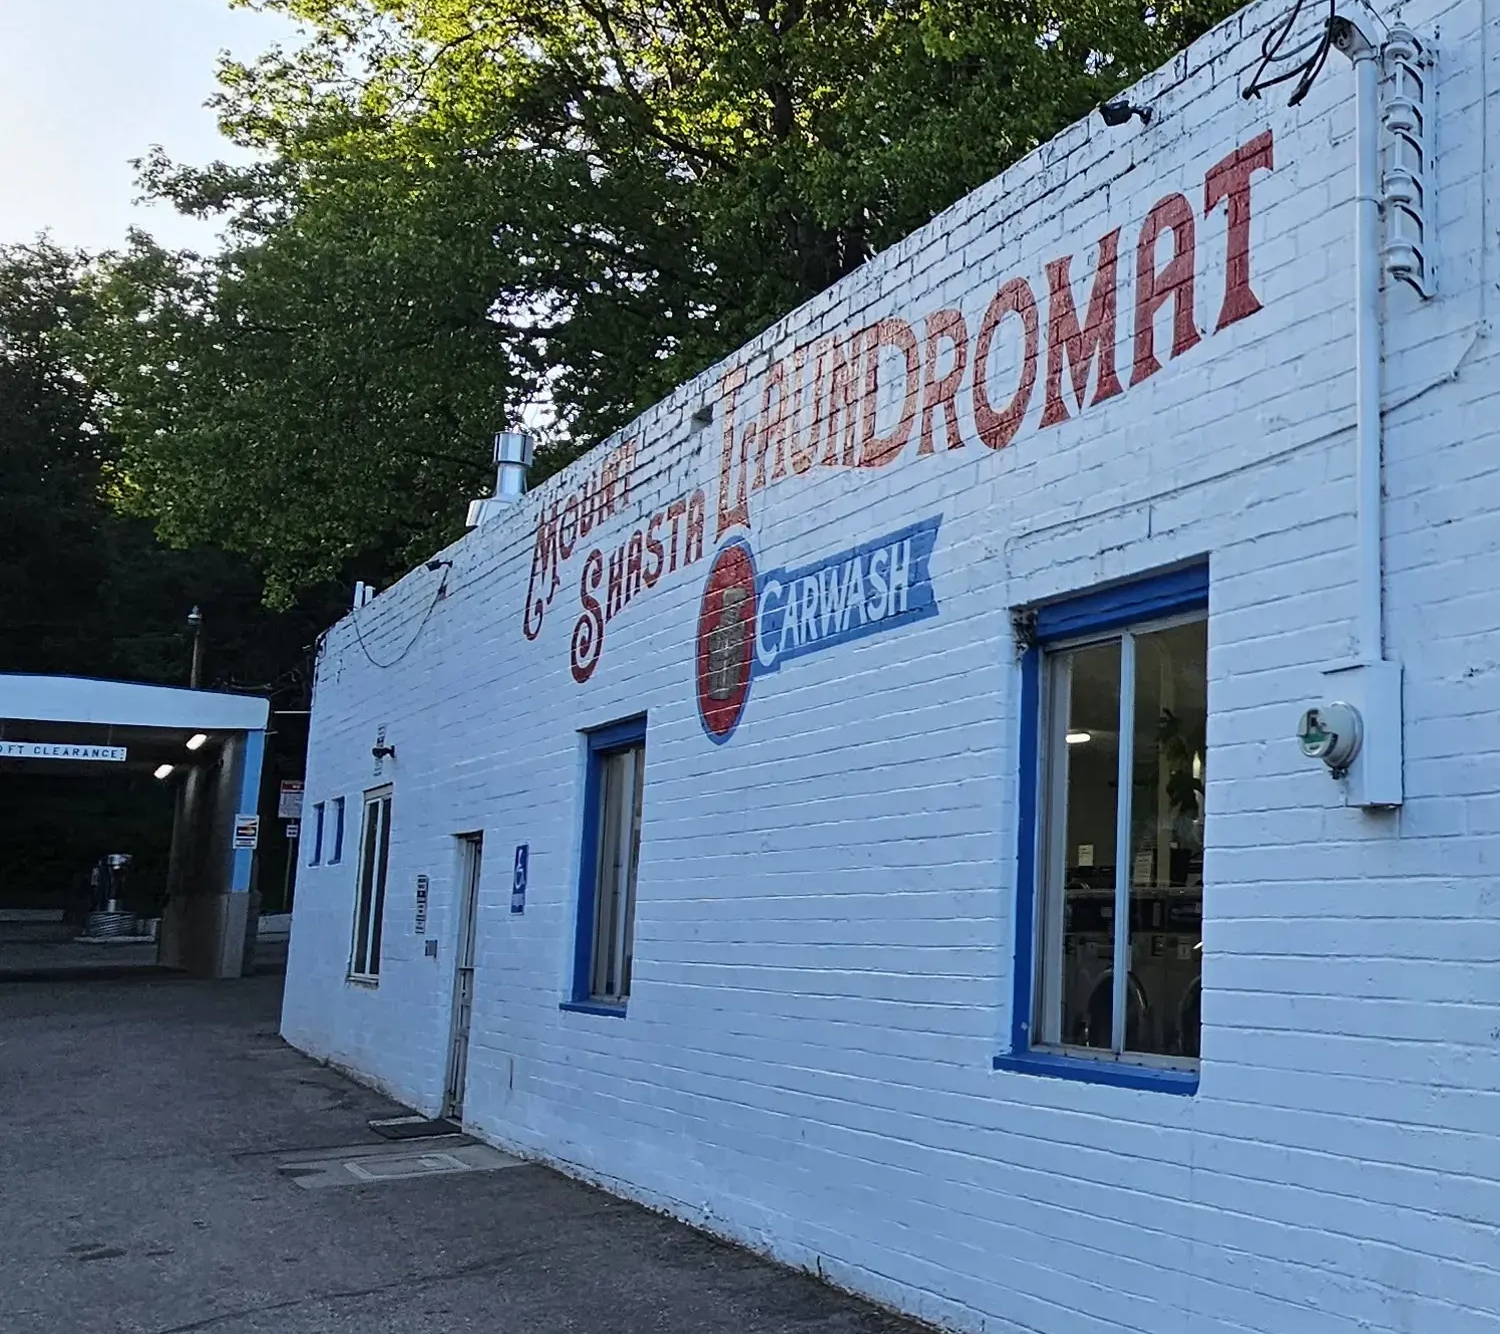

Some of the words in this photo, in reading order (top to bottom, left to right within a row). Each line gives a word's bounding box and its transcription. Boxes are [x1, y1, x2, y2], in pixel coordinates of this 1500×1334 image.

[570, 488, 707, 684] SHASTA
[714, 128, 1275, 545] LAUNDROMAT
[523, 435, 639, 641] MOUNT
[755, 537, 914, 667] CARWASH
[33, 746, 119, 759] CLEARANCE
